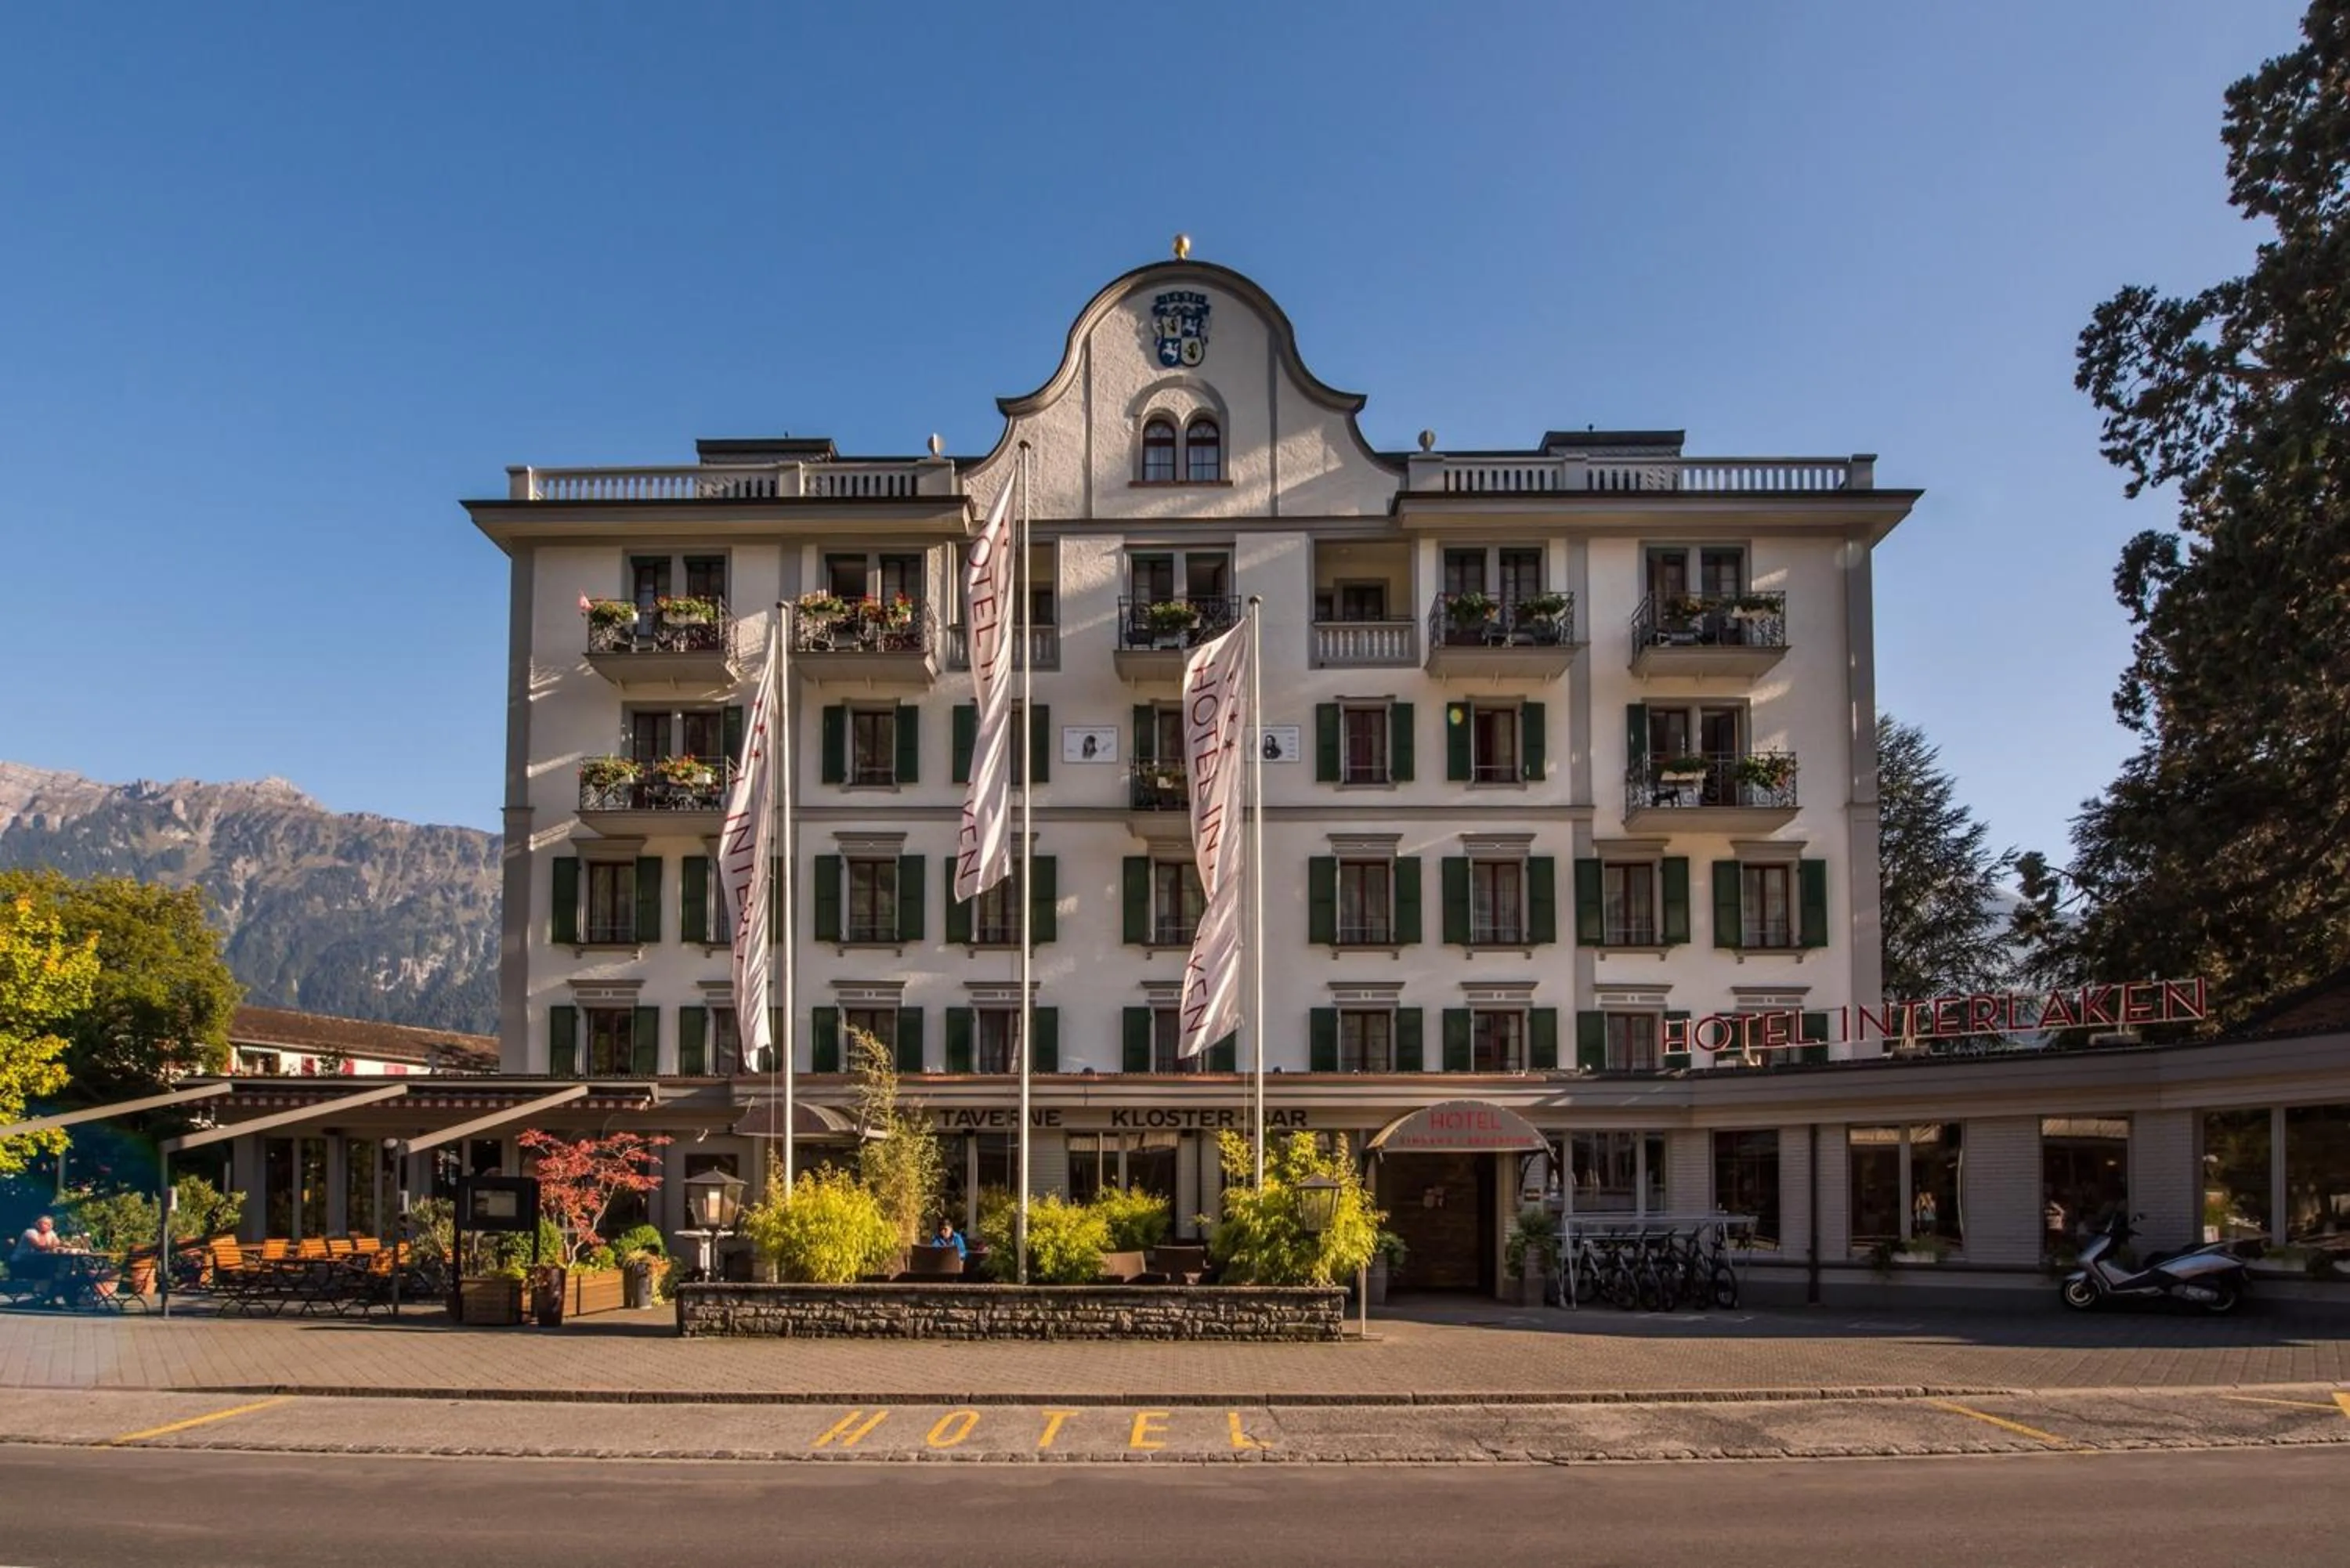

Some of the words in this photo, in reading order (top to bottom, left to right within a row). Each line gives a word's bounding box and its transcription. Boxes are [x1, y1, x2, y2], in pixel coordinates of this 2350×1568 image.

[968, 522, 998, 648] OTEL
[1191, 662, 1219, 802] HOTEL
[1662, 1008, 1820, 1055] HOTEL
[1842, 976, 2207, 1042] INTERLAKEN
[939, 1108, 1062, 1127] TAVERNE
[1111, 1108, 1235, 1127] KLOSTER
[1429, 1111, 1503, 1130] HOTEL
[812, 1408, 1274, 1449] HOTEL
